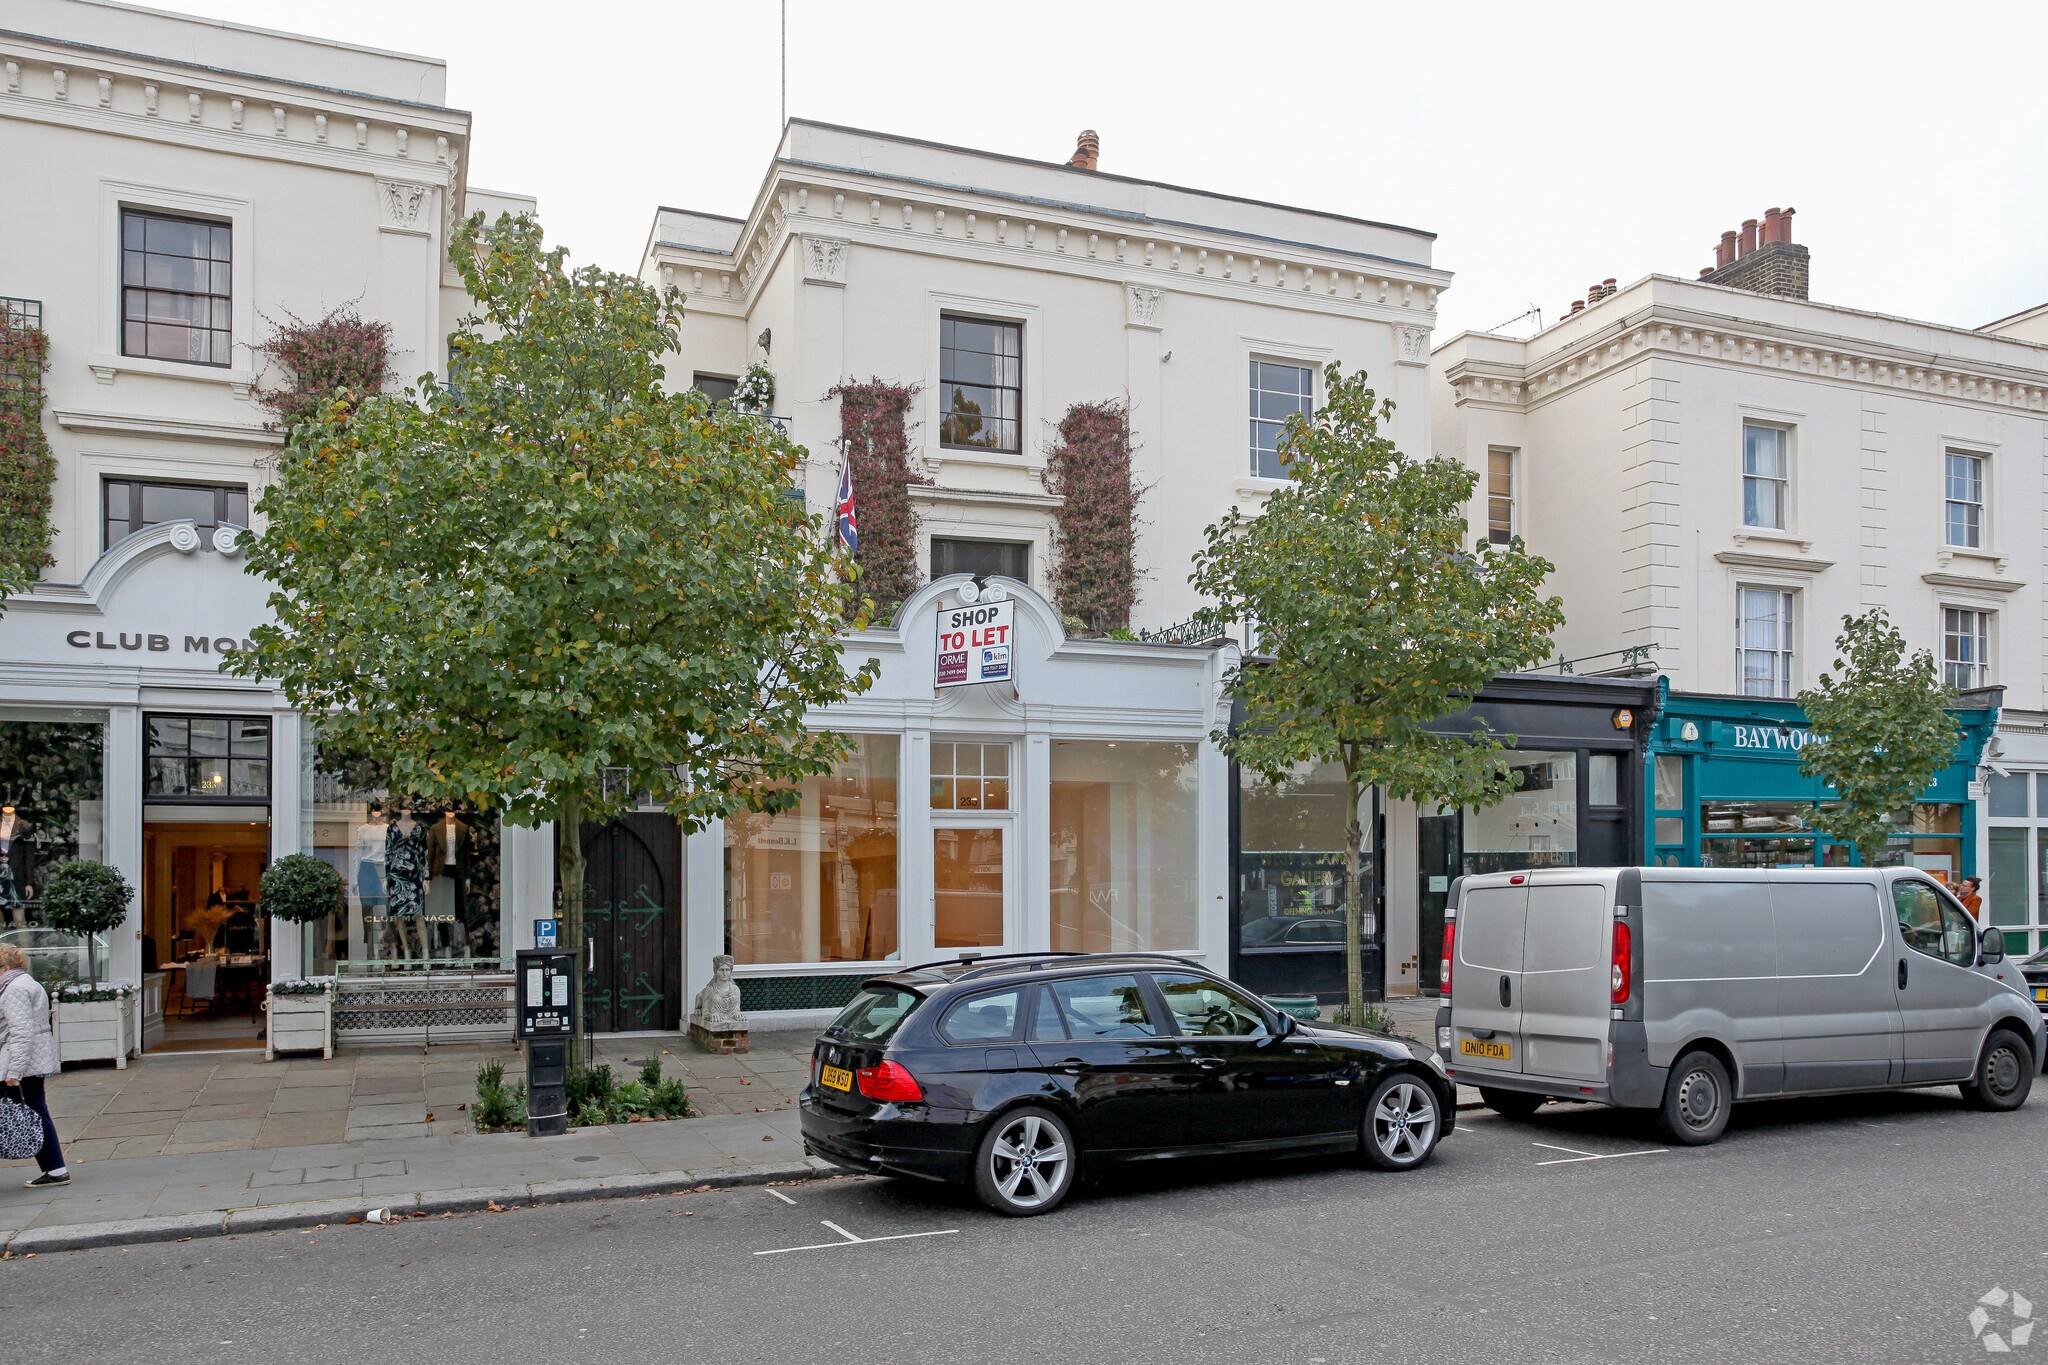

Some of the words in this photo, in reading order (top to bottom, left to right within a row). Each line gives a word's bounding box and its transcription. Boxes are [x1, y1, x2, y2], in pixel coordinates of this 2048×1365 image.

[951, 607, 999, 629] SHOP
[66, 630, 170, 652] CLUB
[184, 635, 258, 654] MON
[940, 631, 965, 651] TO
[971, 625, 1009, 648] LET
[940, 653, 966, 666] ORME
[993, 652, 1007, 661] klm
[960, 797, 978, 806] 235
[1281, 870, 1336, 887] GALLERY
[364, 915, 398, 923] CLUB
[541, 922, 552, 936] P
[1465, 1041, 1485, 1055] DN10
[1486, 1044, 1504, 1057] FDA
